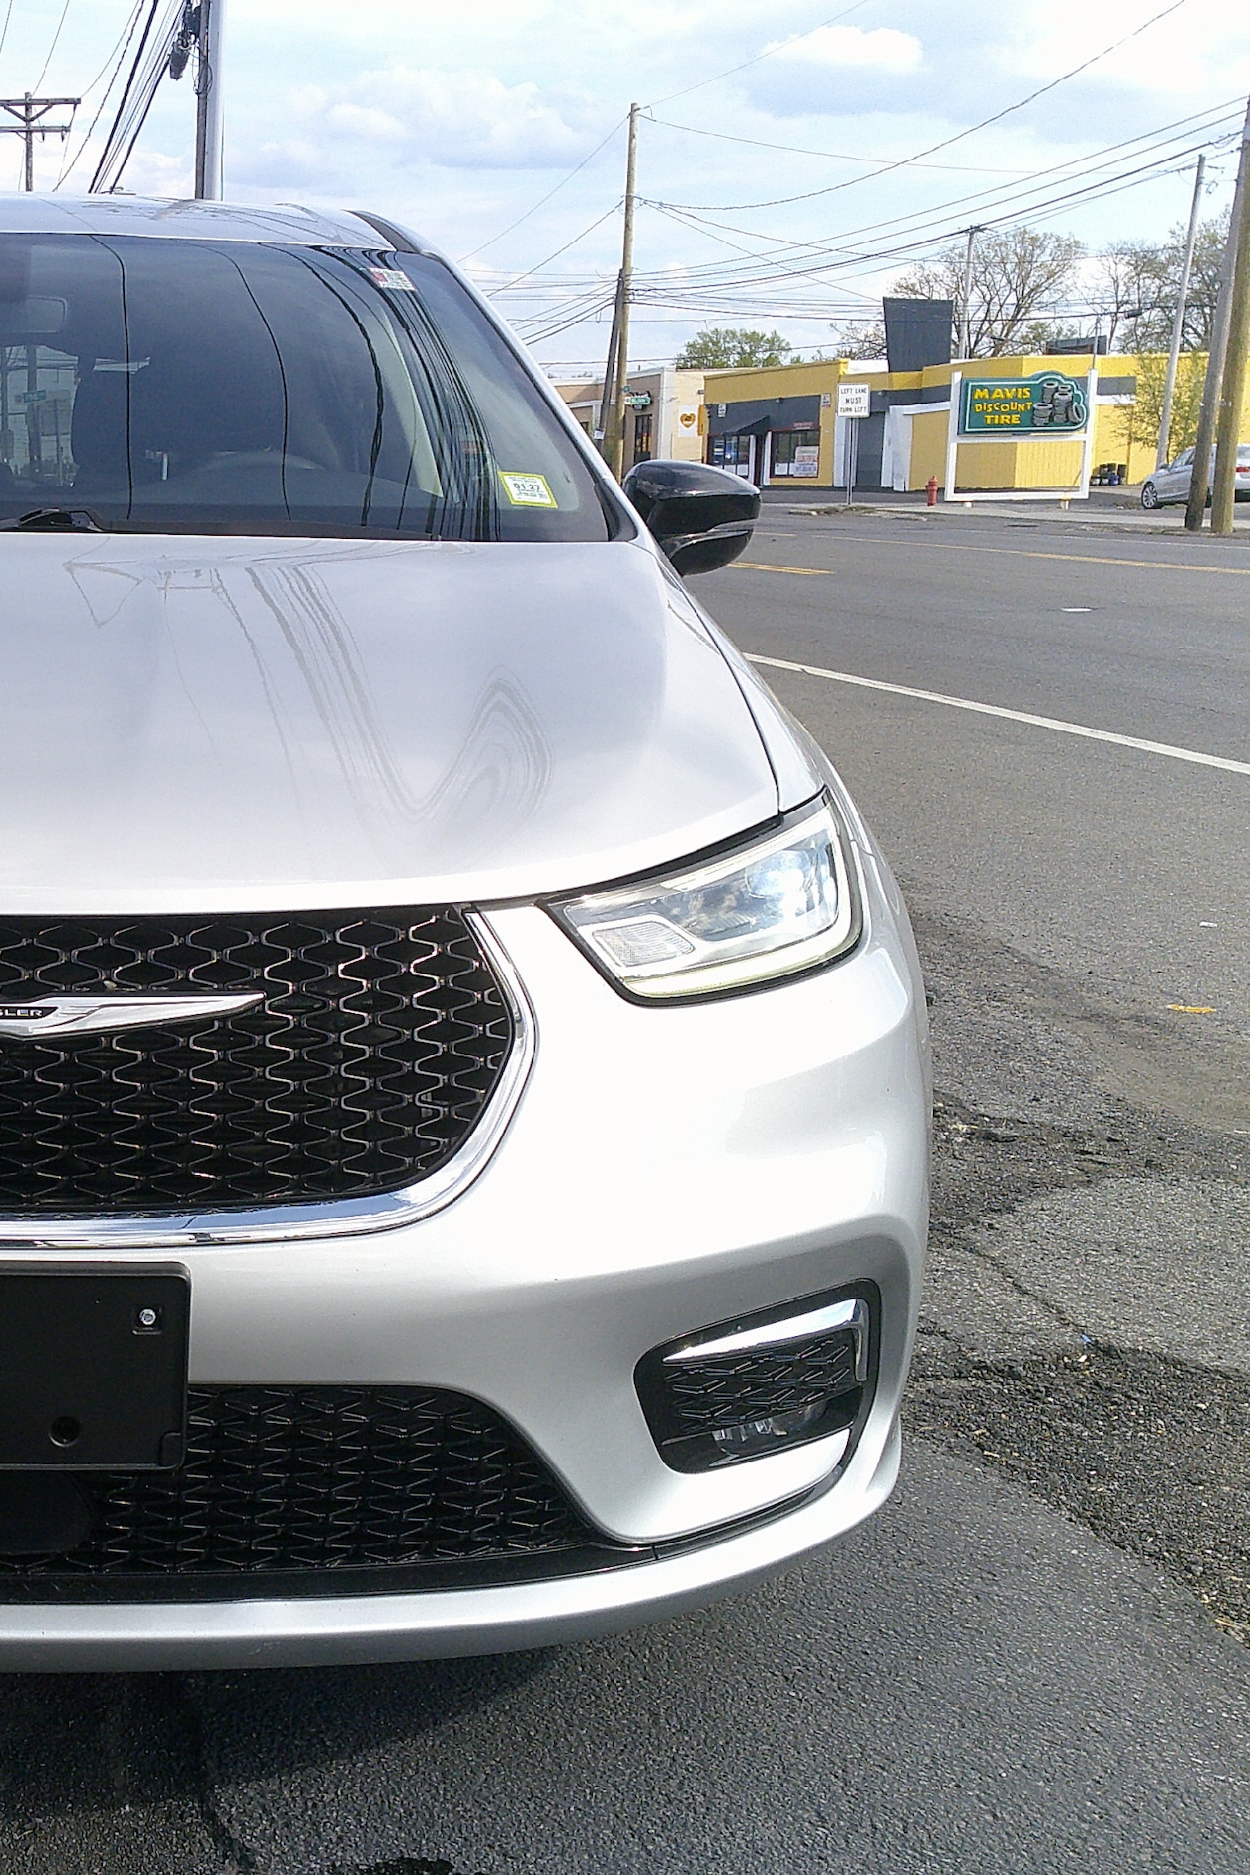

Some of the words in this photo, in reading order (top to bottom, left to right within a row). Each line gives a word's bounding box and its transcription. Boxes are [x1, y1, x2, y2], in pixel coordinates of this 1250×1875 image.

[840, 387, 853, 395] LEFT
[973, 387, 1031, 400] MAVIS
[845, 397, 862, 405] MUST
[974, 402, 1032, 413] DISCOUNT
[984, 414, 1021, 425] TIRE
